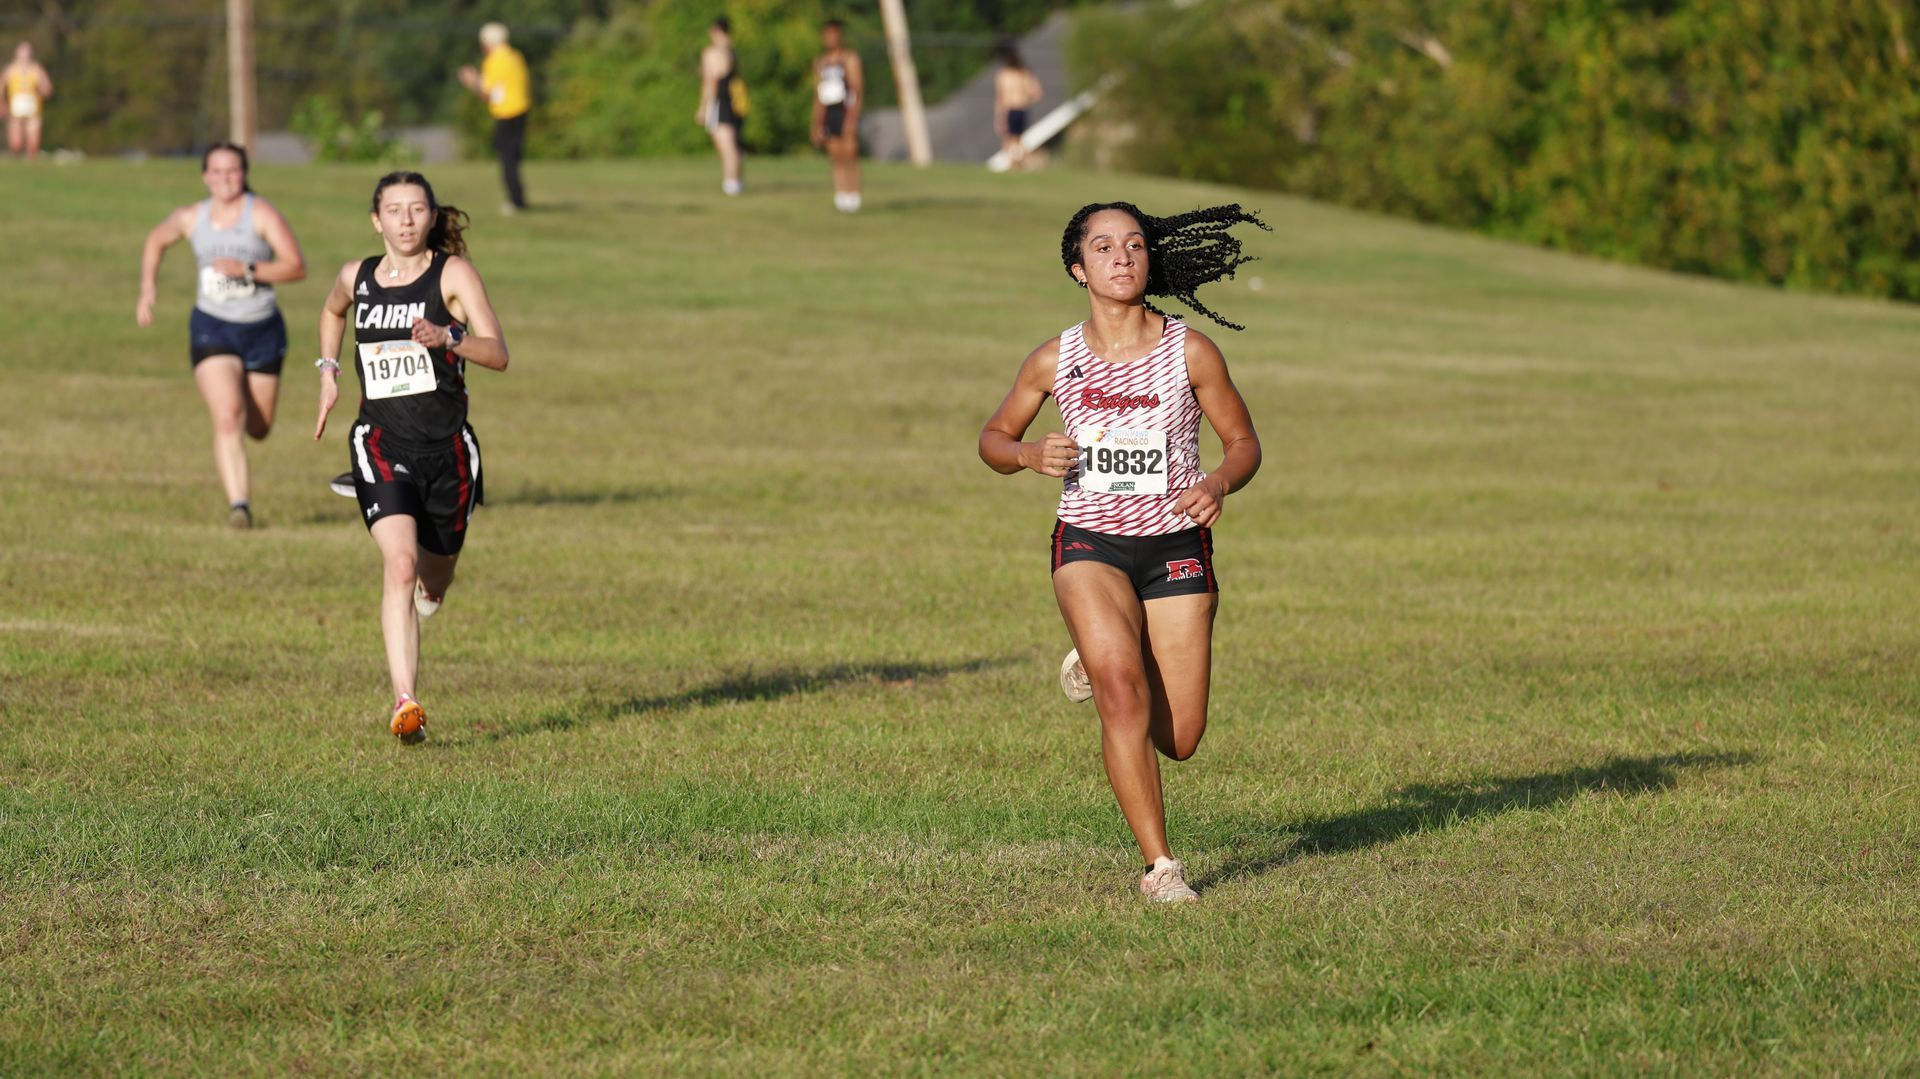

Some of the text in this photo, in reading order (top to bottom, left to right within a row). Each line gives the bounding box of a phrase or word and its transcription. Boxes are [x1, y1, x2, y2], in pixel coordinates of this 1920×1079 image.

[355, 302, 426, 329] CAIRN
[367, 354, 429, 381] 19704
[1078, 388, 1161, 416] Rutgers
[1114, 437, 1149, 446] RACING CO
[1083, 446, 1163, 475] 19832
